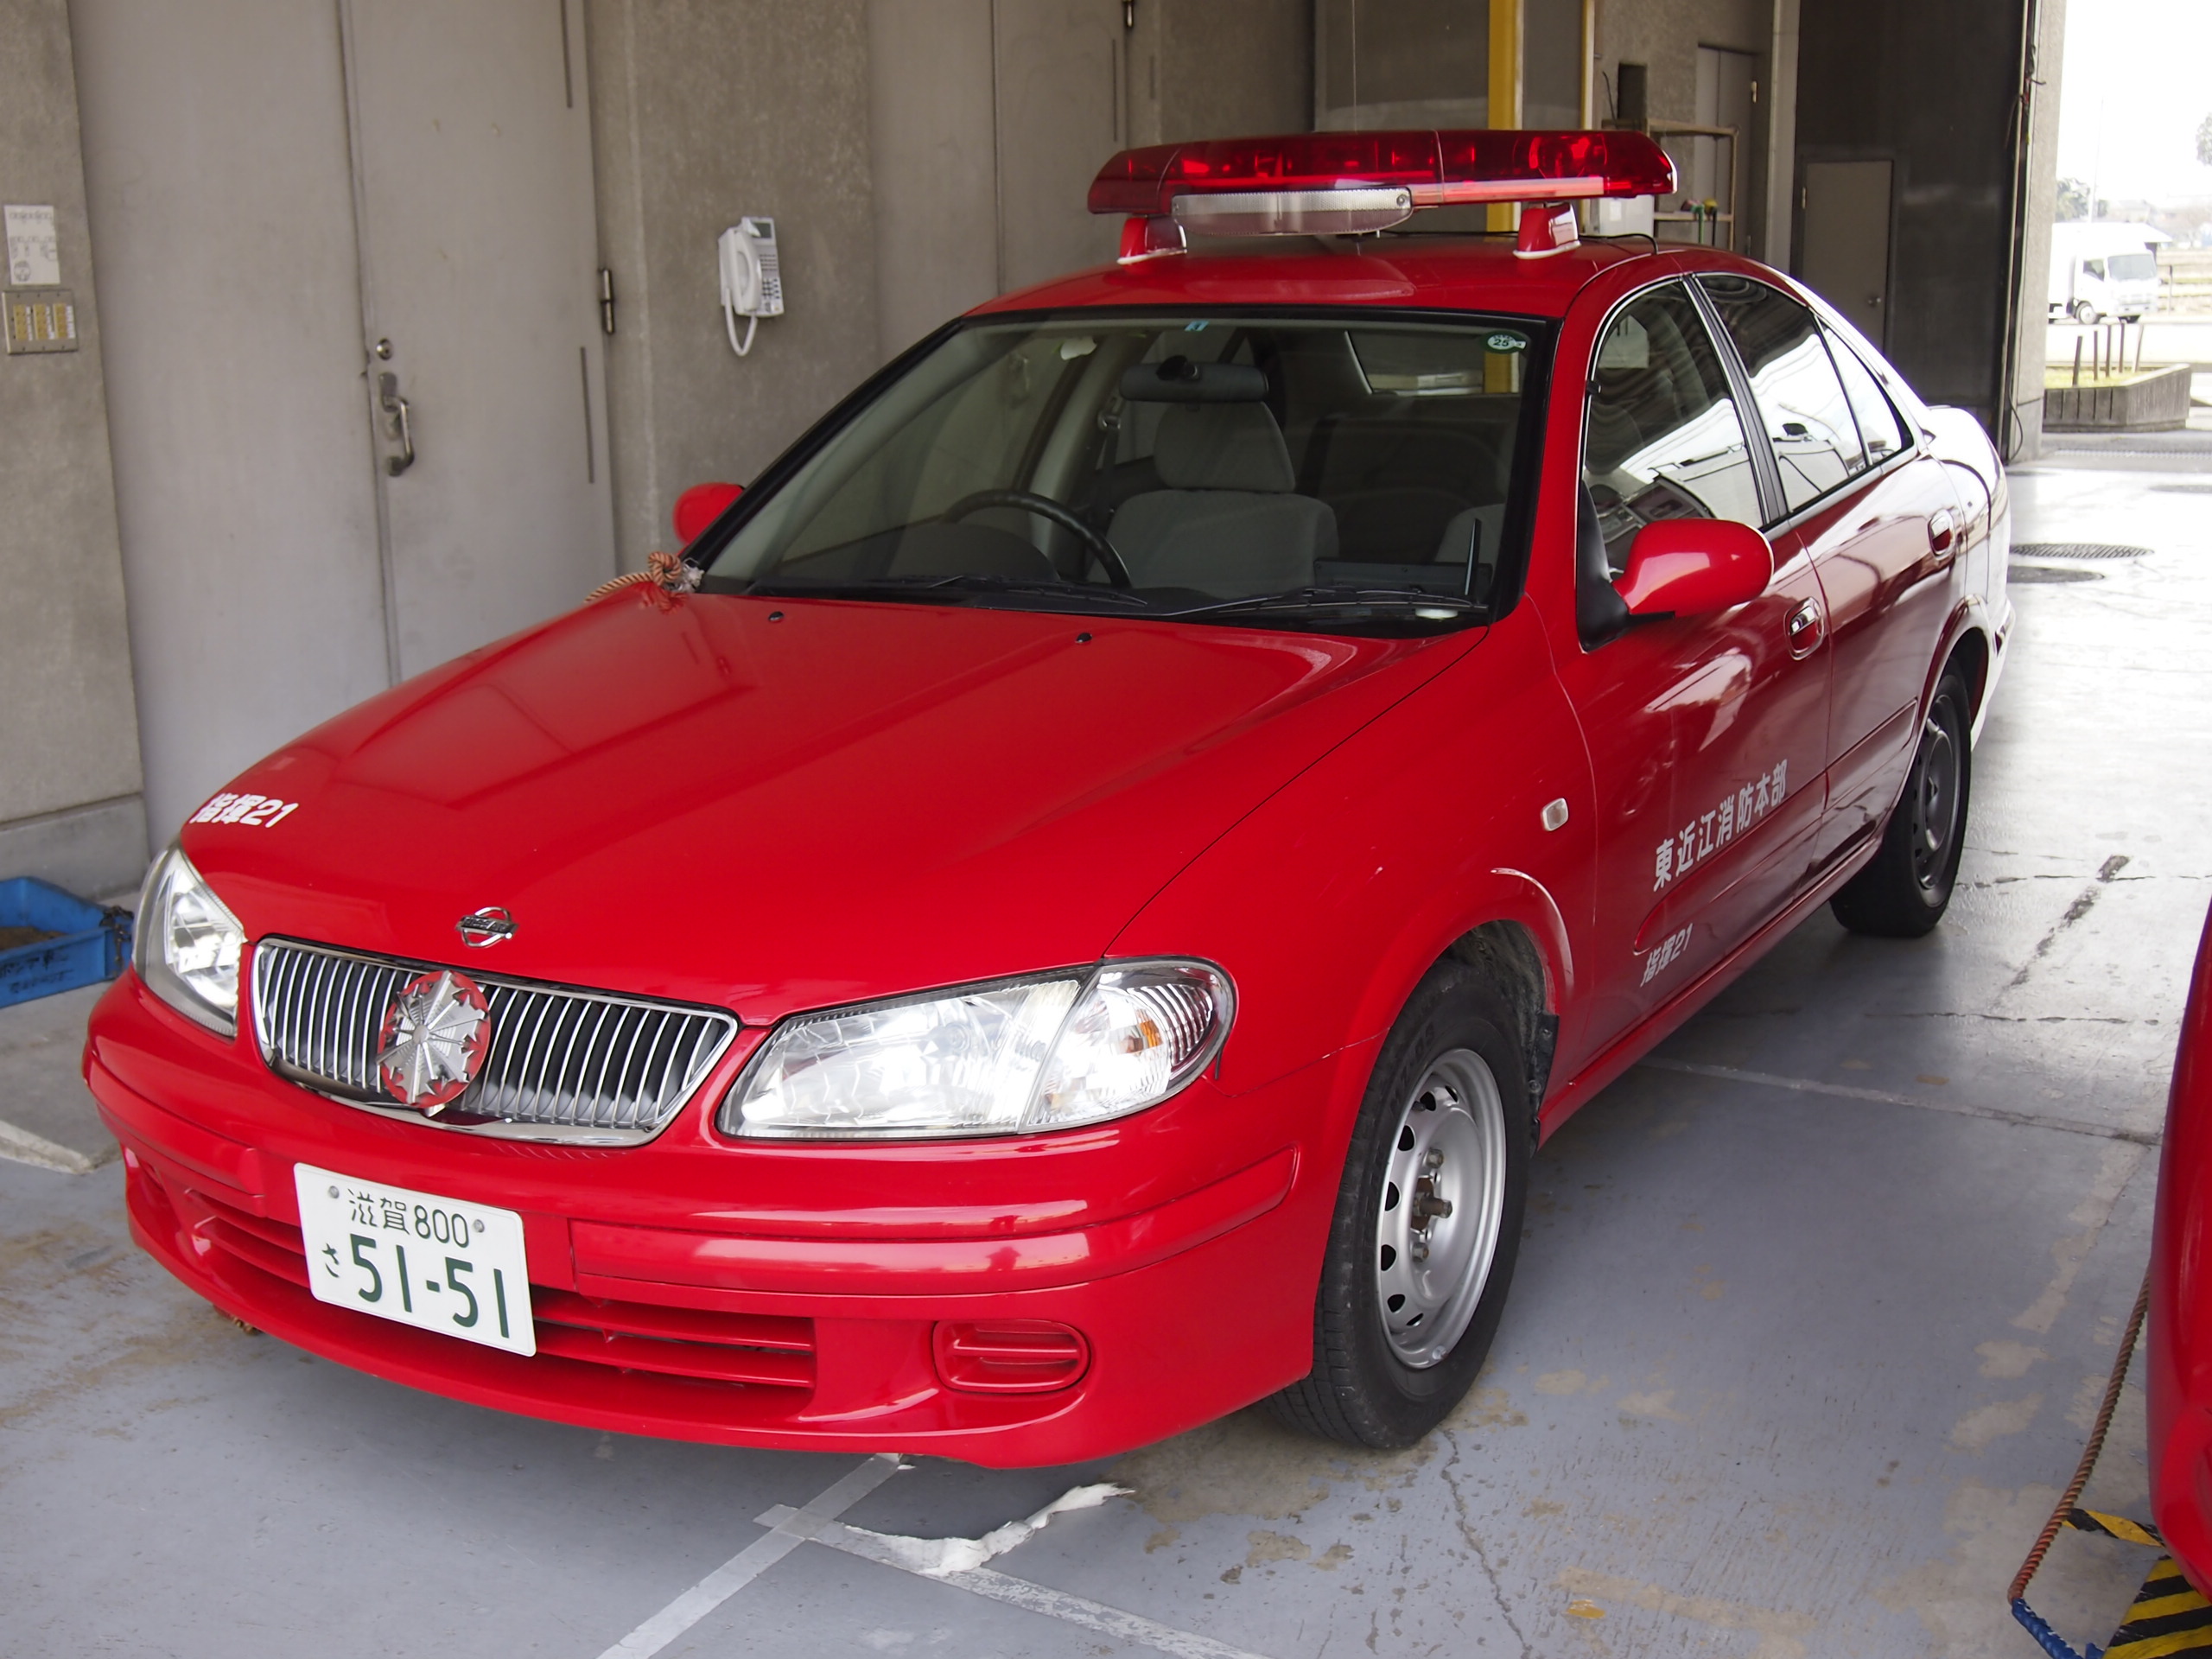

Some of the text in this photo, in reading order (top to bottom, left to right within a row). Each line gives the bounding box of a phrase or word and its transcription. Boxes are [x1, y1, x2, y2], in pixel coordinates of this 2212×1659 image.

[1653, 759, 1787, 893] 東近江消防本部
[350, 1233, 510, 1339] 51-51
